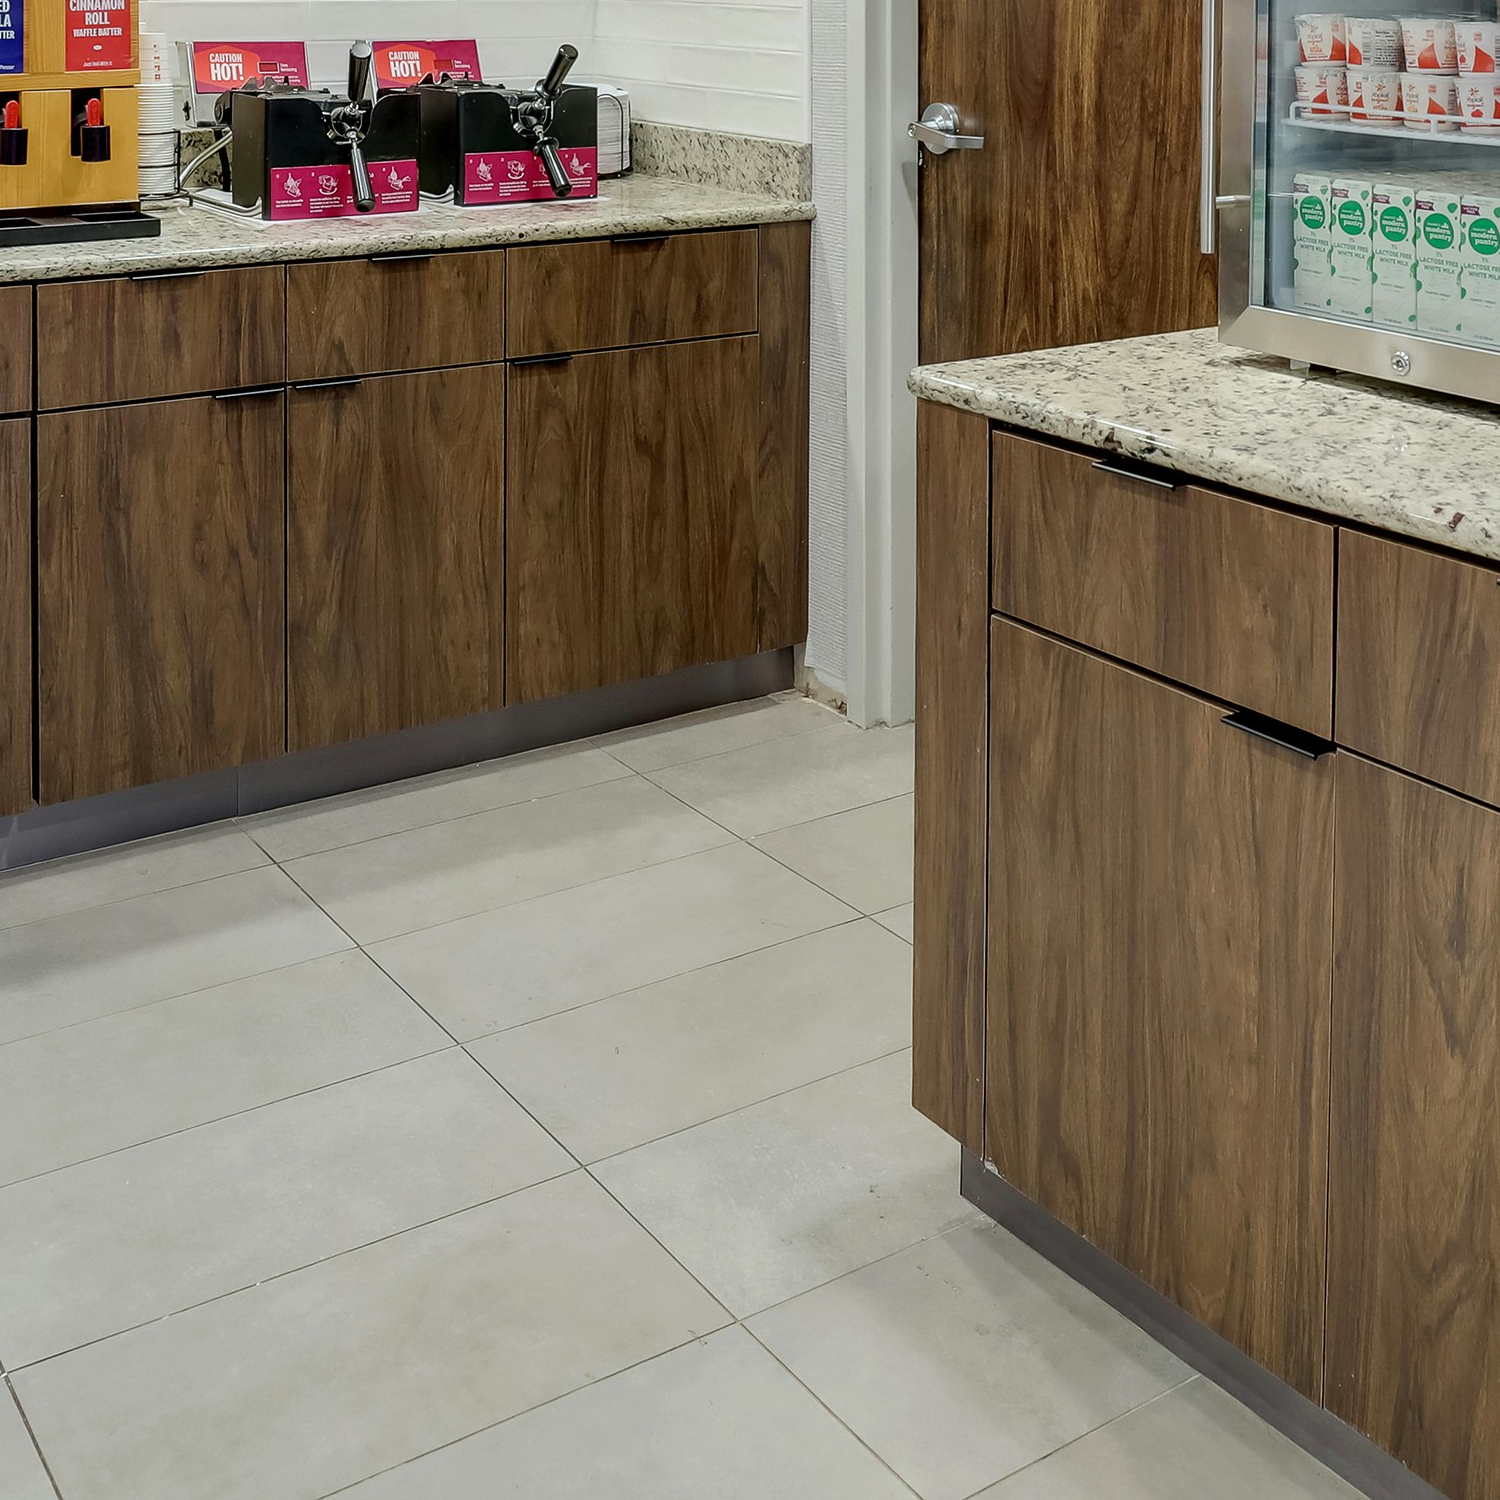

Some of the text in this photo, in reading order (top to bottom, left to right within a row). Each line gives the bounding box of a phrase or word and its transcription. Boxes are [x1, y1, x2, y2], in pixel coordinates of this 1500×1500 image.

[84, 12, 110, 25] ROLL
[73, 27, 123, 38] WAFFLE BATTER
[209, 53, 242, 63] CAUTION
[389, 51, 419, 61] CAUTION
[210, 63, 244, 81] HOT!
[390, 60, 422, 78] HOT!
[1305, 214, 1323, 222] pantry
[1340, 214, 1362, 222] modern
[1344, 220, 1363, 228] pantry
[1382, 220, 1406, 228] modern
[1386, 227, 1406, 235] pantry
[1425, 226, 1451, 235] modern
[1429, 233, 1451, 243] pantry
[1470, 232, 1498, 240] modern
[1474, 238, 1499, 248] pantry
[1375, 249, 1399, 258] LACTOSE
[1419, 257, 1459, 268] LACTOSE FREE
[1424, 265, 1442, 273] WHITE
[1463, 263, 1490, 272] LACTOSE
[1468, 271, 1500, 281] WHITE MILK
